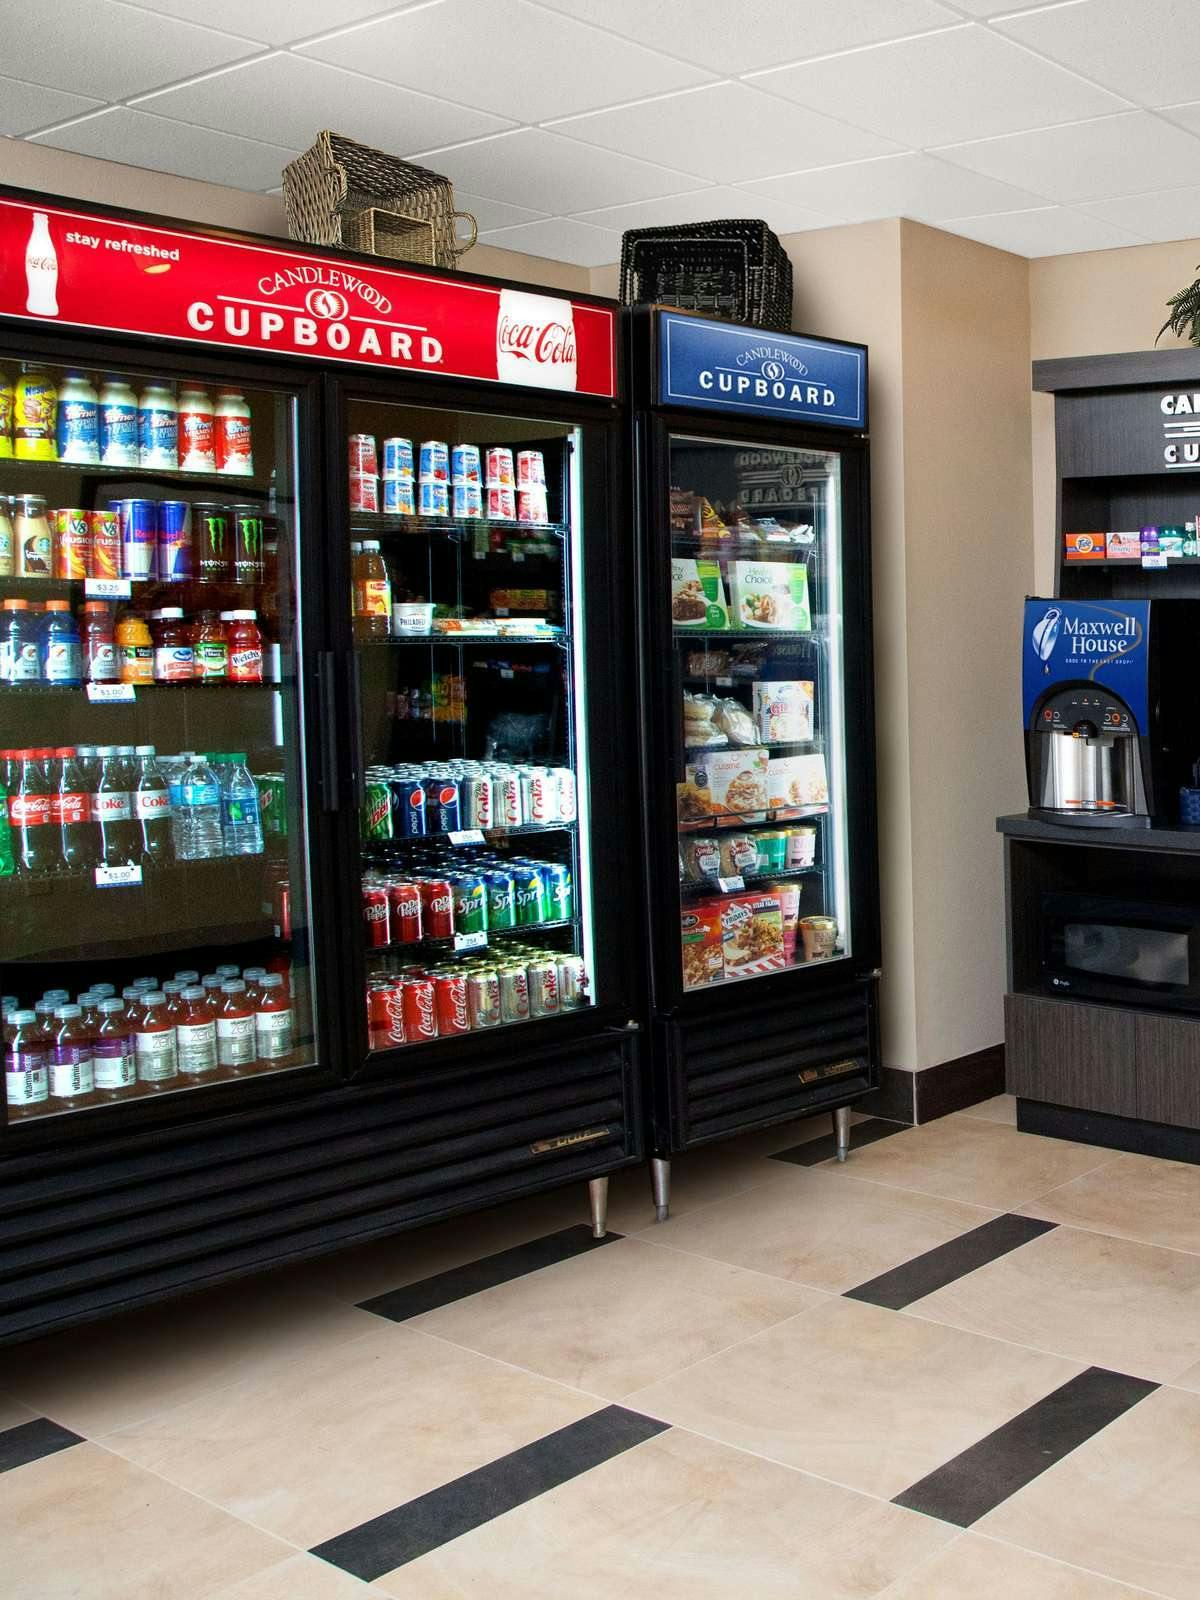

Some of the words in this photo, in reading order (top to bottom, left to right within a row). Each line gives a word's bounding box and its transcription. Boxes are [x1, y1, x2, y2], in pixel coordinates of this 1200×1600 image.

[66, 231, 100, 249] stay
[105, 238, 180, 261] refreshed
[258, 266, 392, 314] CANDLEWOOD
[187, 302, 444, 363] CUPBOARD
[499, 315, 576, 363] Coca-Cola
[736, 347, 808, 377] CANDLEWOOD
[699, 371, 835, 407] CUPBOARD
[72, 520, 87, 534] V8
[103, 523, 117, 536] V8
[1063, 616, 1136, 636] Maxwell
[1072, 636, 1128, 654] House
[476, 782, 488, 824] Coke
[506, 780, 517, 822] Coke
[532, 778, 544, 819] Coke
[410, 811, 419, 834] pepsi
[440, 808, 448, 831] pepsi
[386, 986, 405, 1043] Coca-Cola
[416, 983, 435, 1036] Coca-Cola
[450, 979, 468, 1030] Coca-Cola
